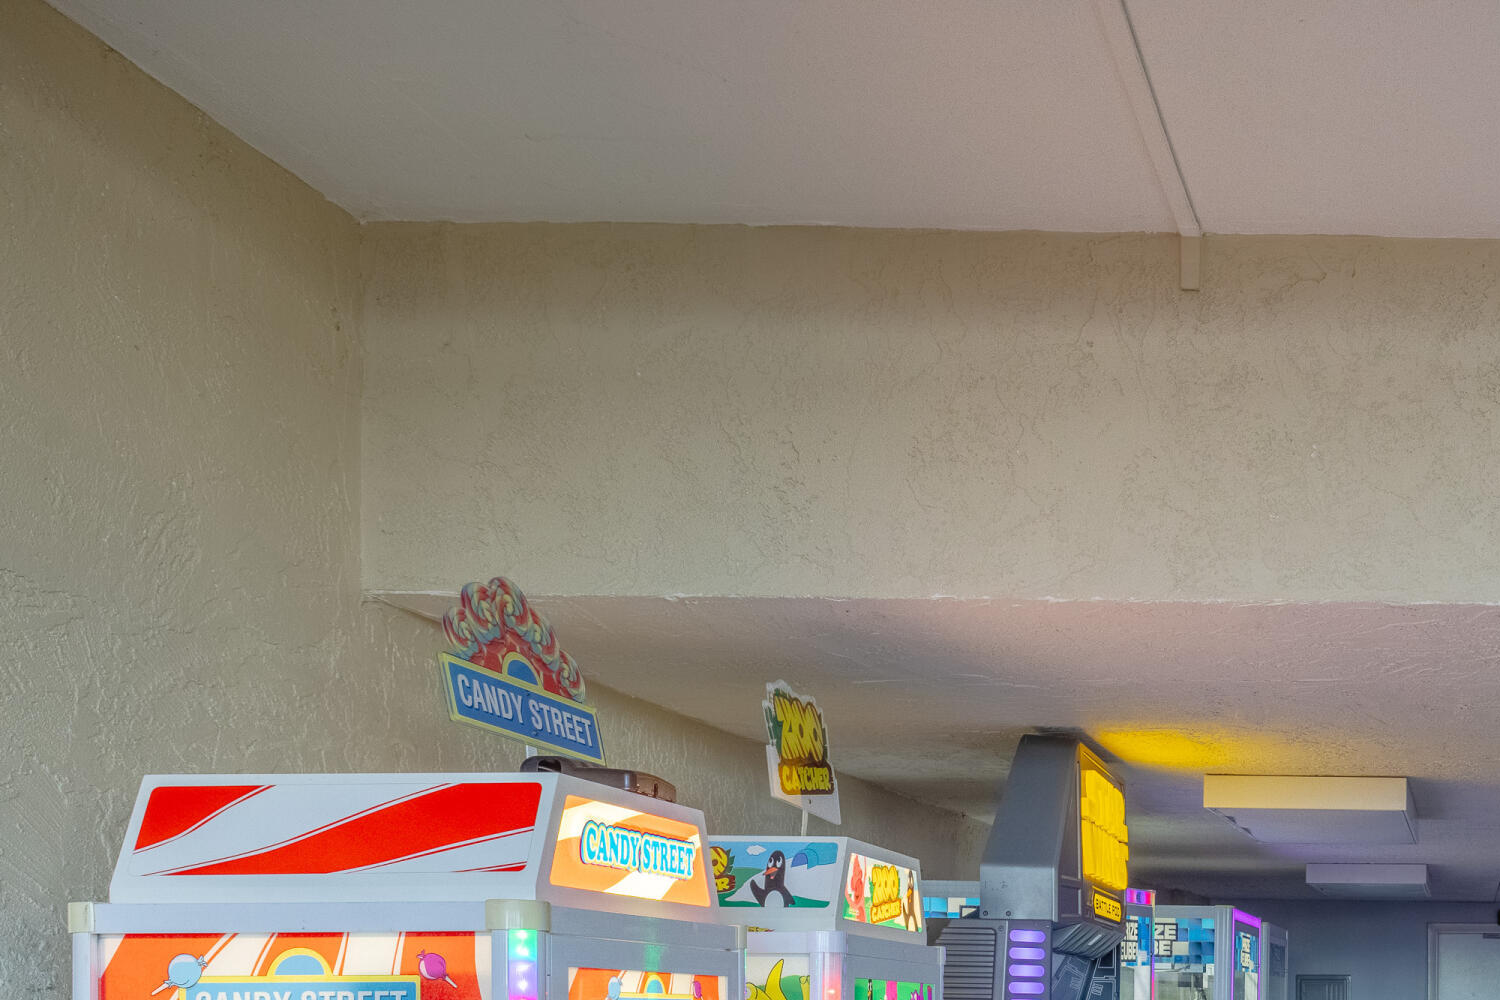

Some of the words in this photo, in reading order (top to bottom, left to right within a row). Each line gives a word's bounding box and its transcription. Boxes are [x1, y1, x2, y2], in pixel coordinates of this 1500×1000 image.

[457, 673, 524, 724] CANDY
[528, 699, 593, 748] STREET
[782, 764, 832, 791] CATCHER
[583, 822, 641, 870] CANDY
[641, 834, 695, 880] STREET
[871, 865, 899, 906] ZOO
[871, 899, 901, 922] CATCHER
[1096, 897, 1112, 914] BATTLE
